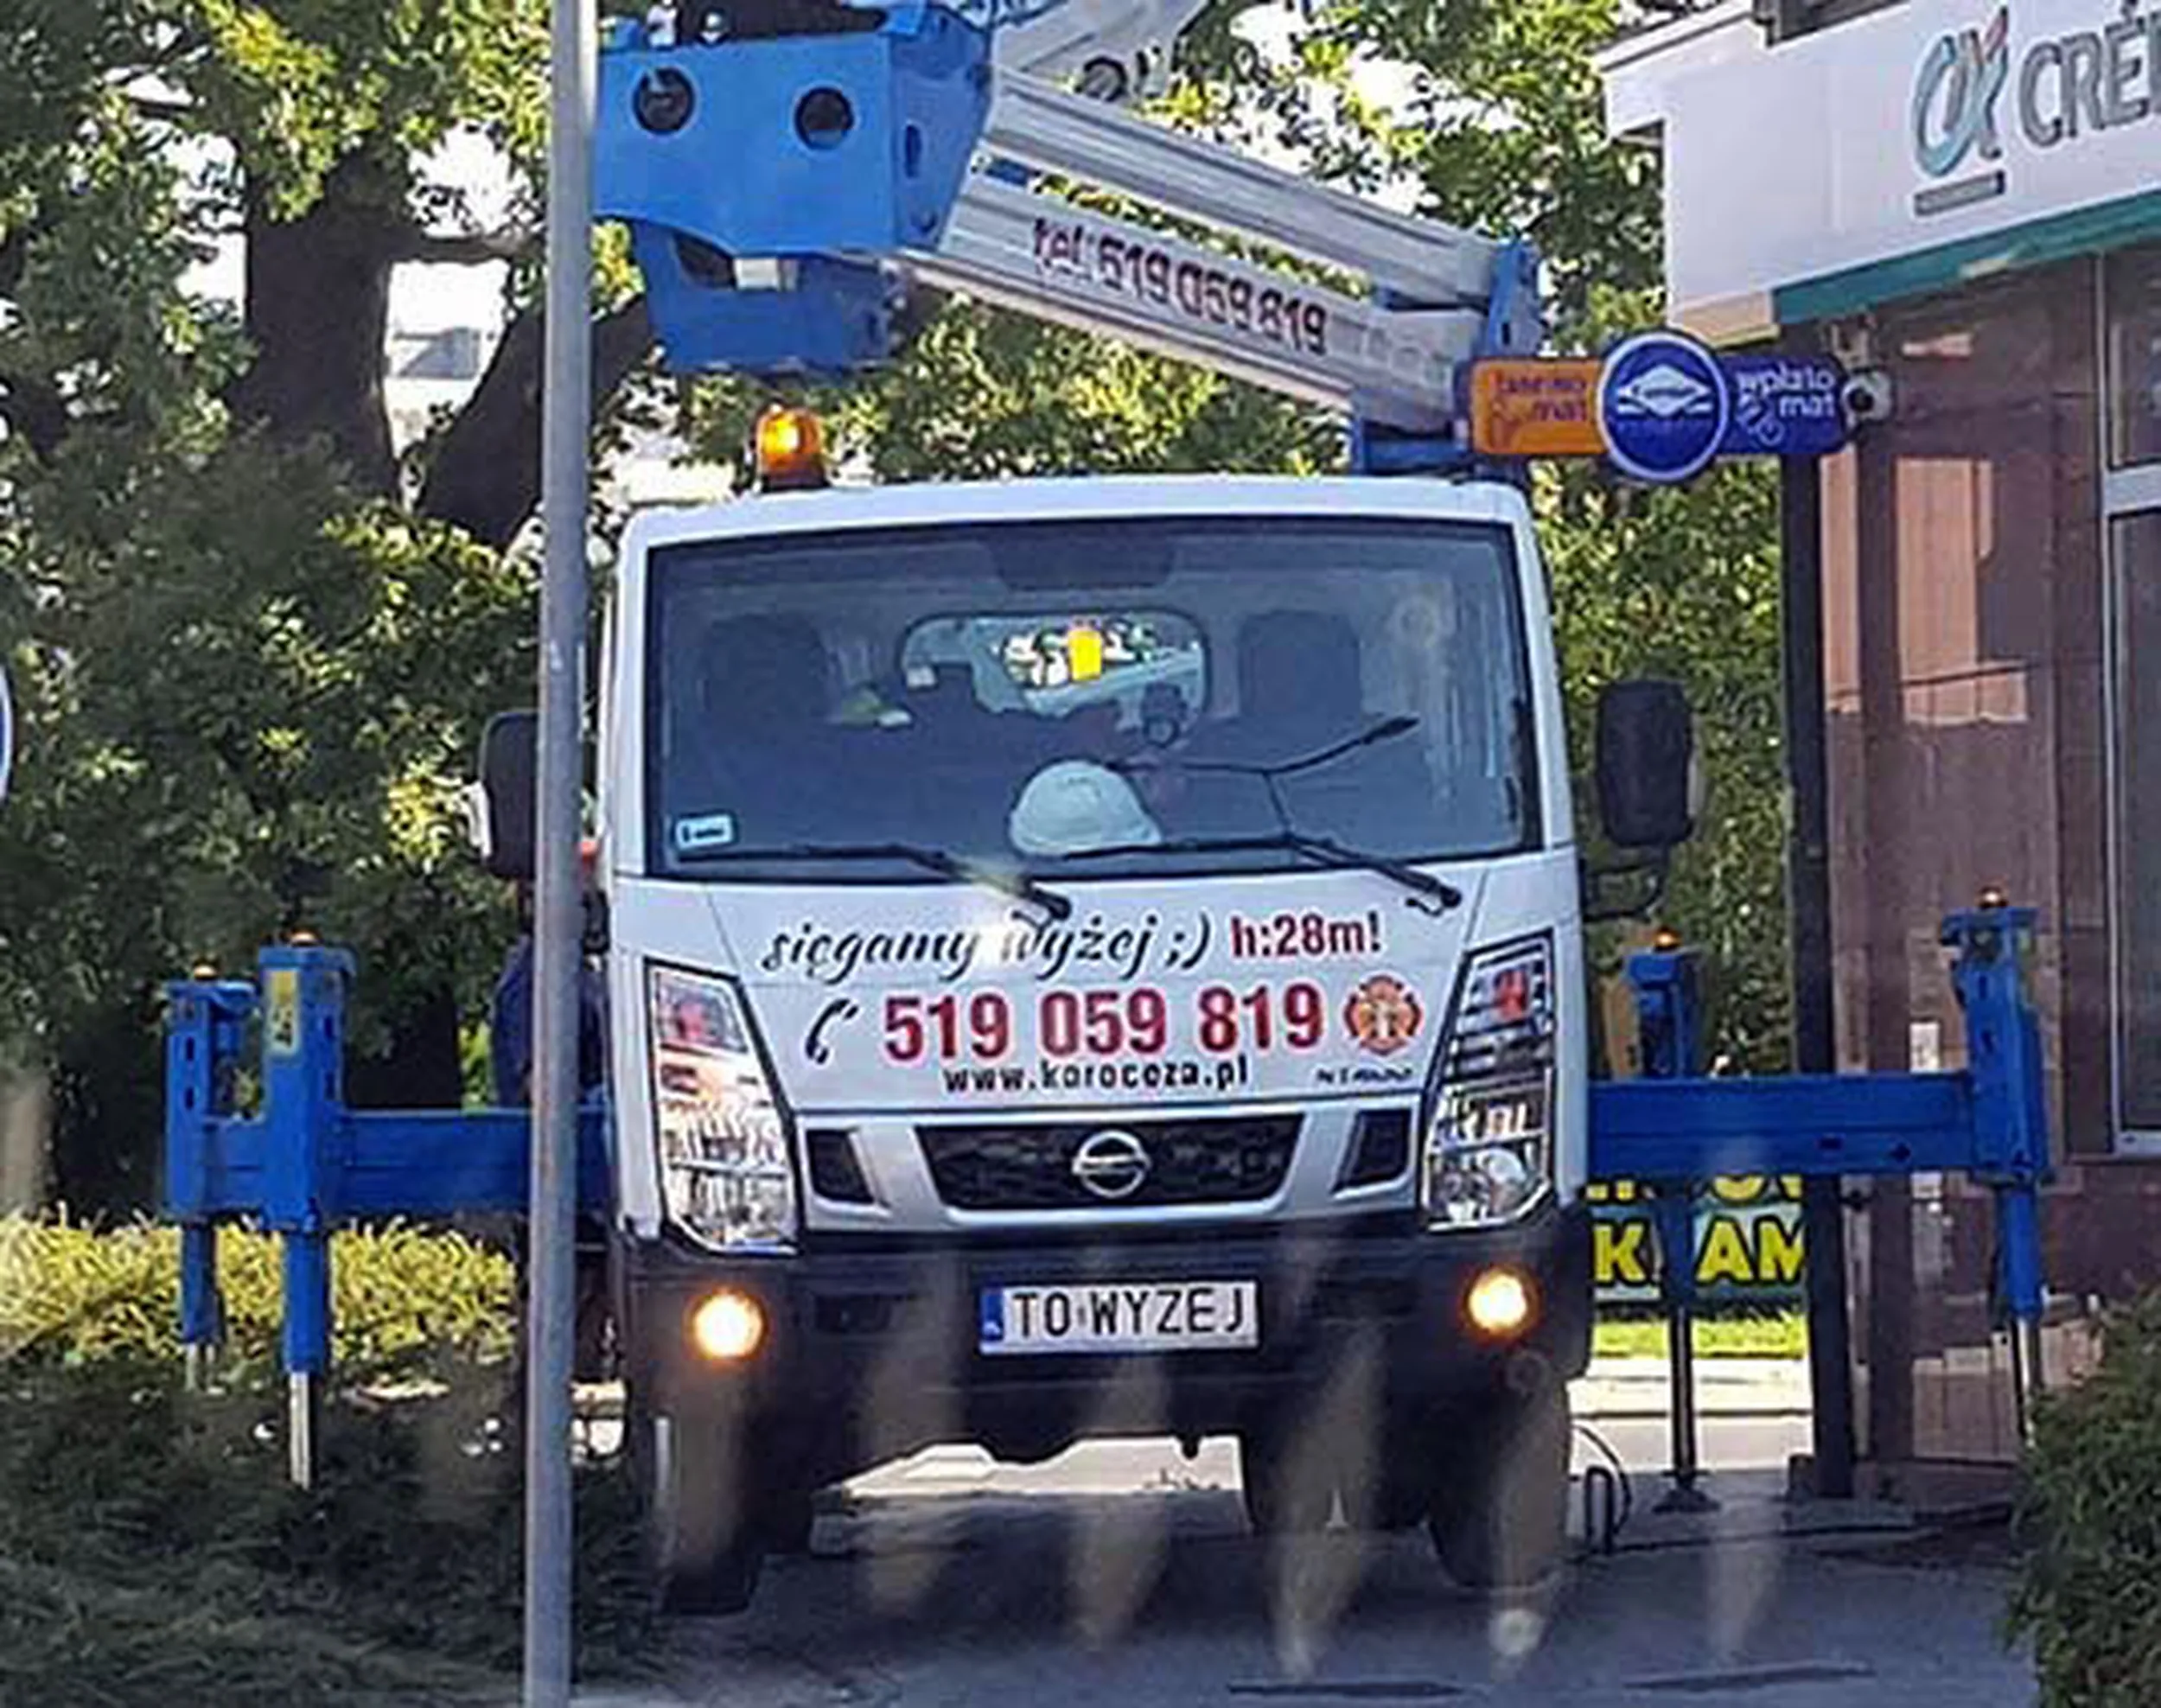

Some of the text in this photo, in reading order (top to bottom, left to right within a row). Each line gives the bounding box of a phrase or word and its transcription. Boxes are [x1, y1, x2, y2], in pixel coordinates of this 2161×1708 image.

[762, 921, 980, 985] sięgamy
[1230, 910, 1381, 958] h:28m!
[885, 981, 1322, 1061] 519 059 819
[1011, 1287, 1243, 1337] TO WYZEJ
